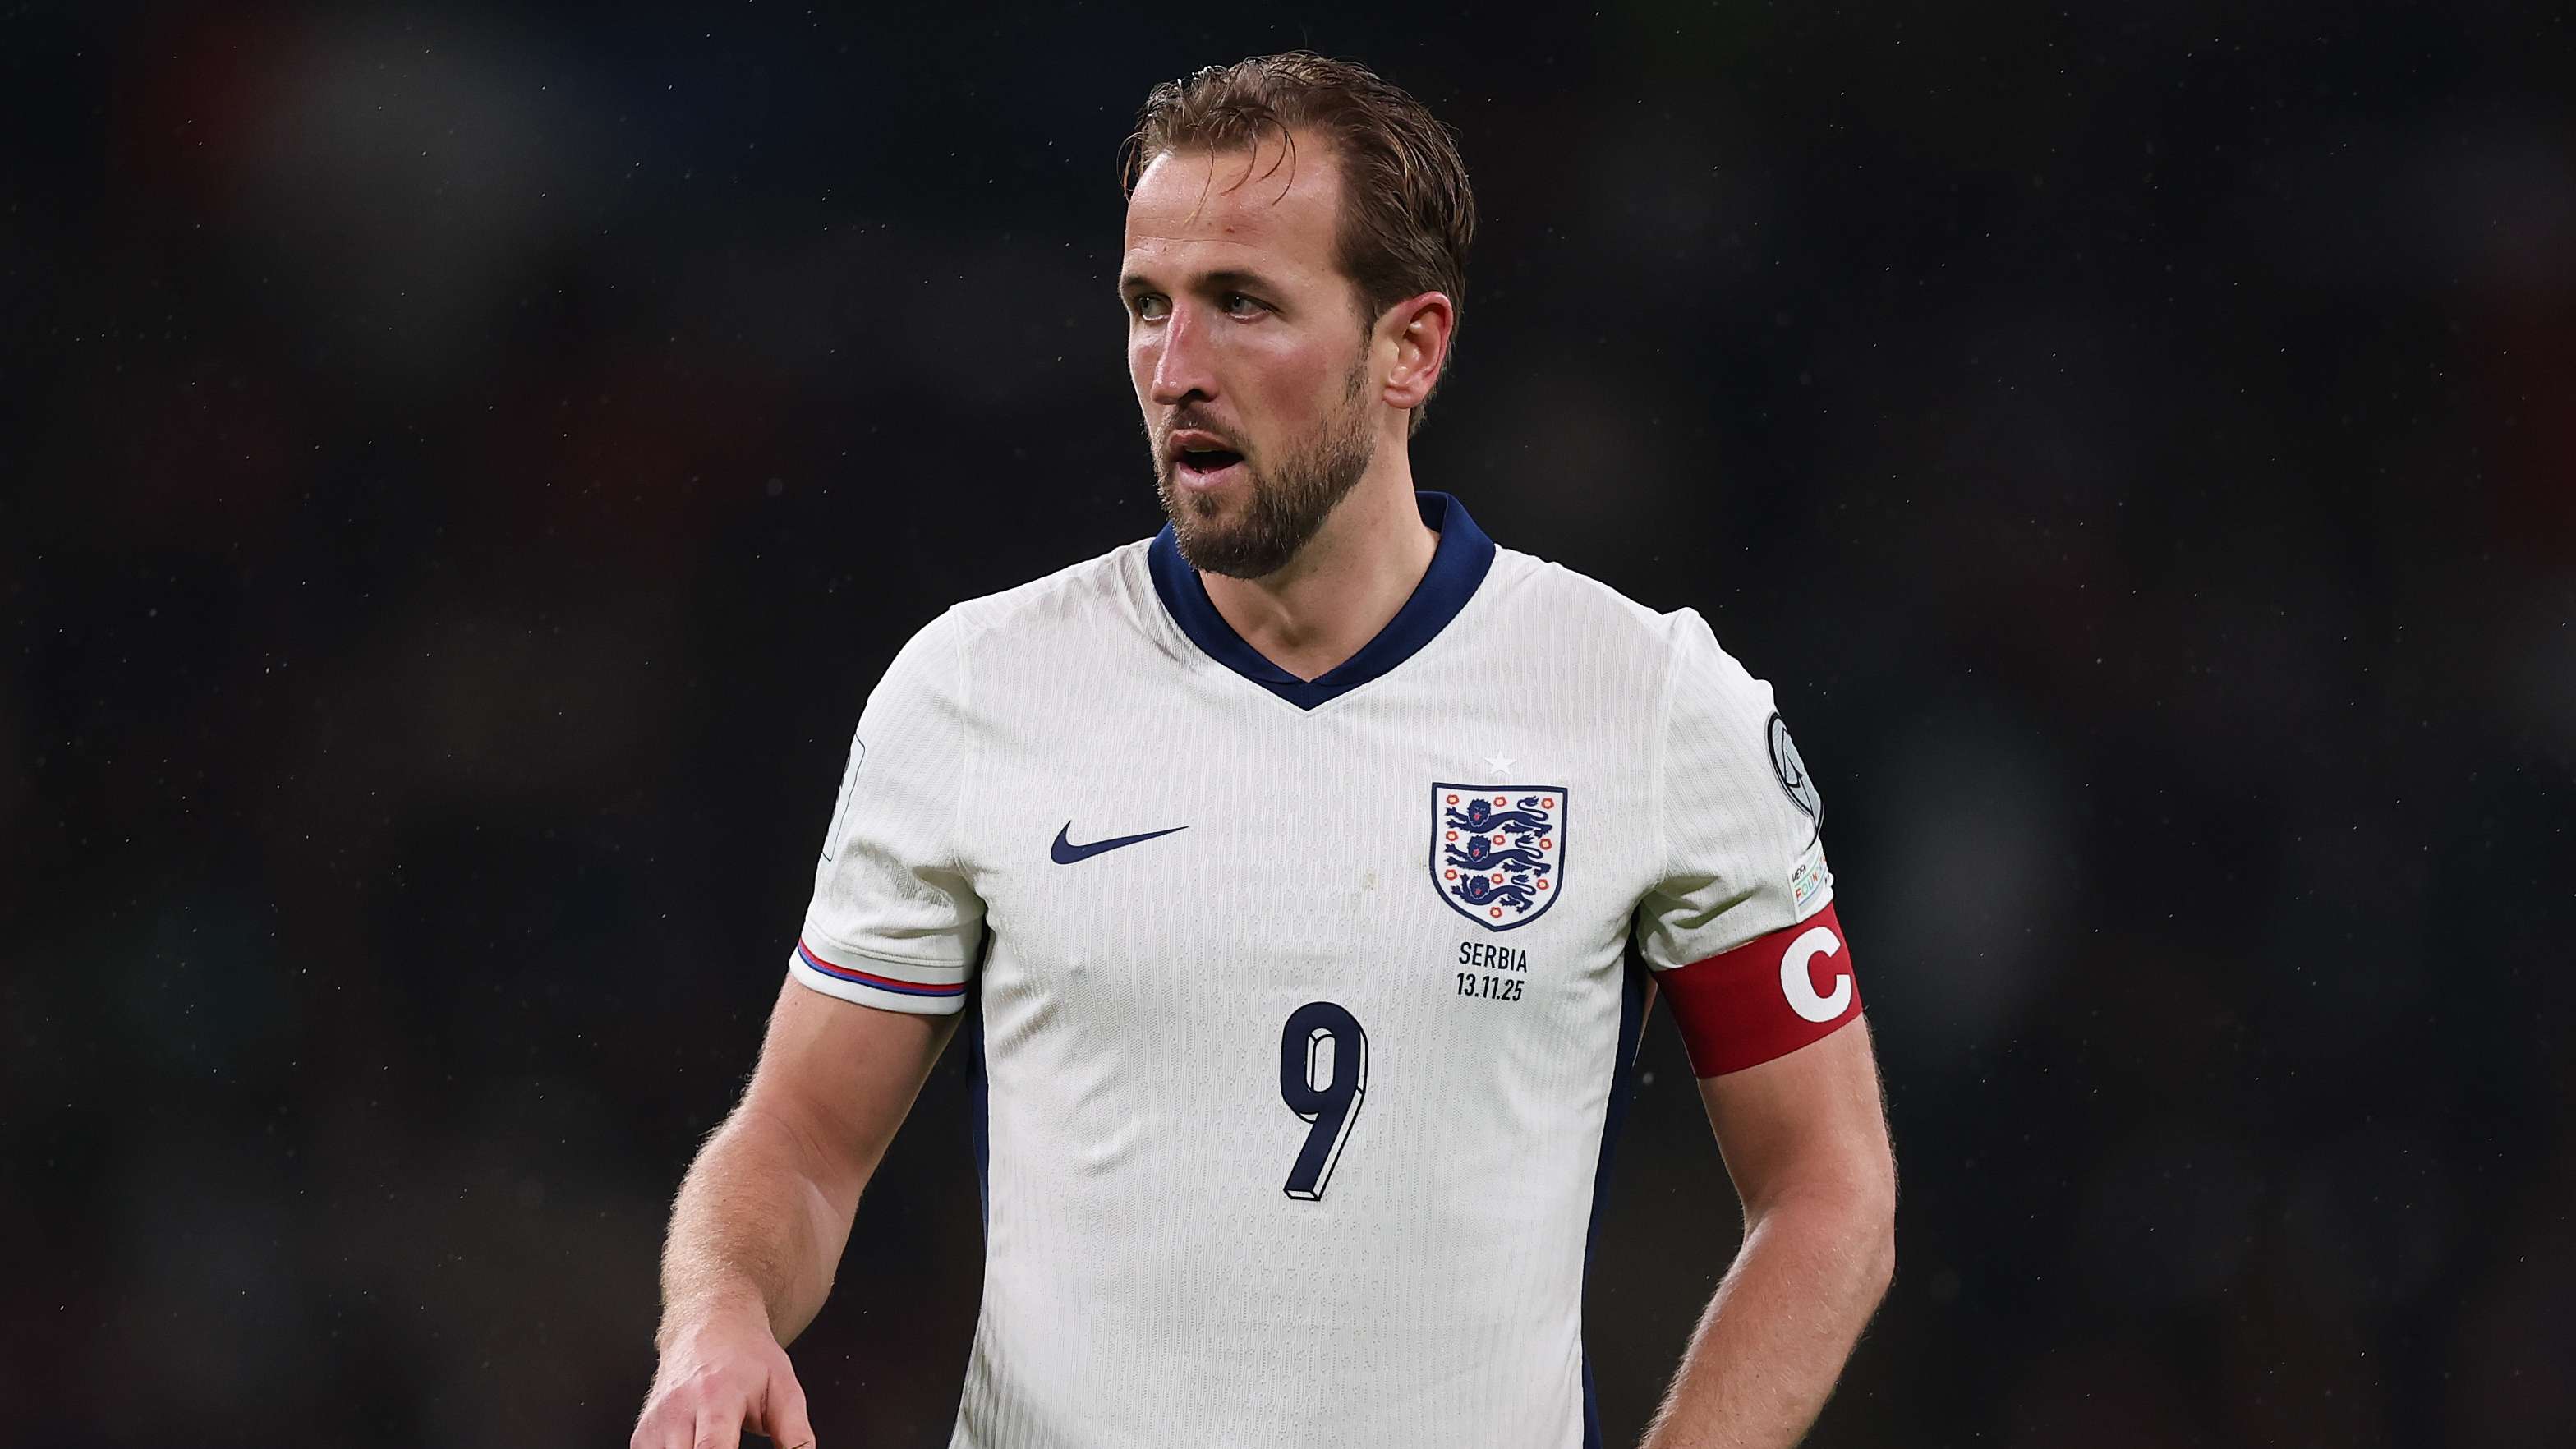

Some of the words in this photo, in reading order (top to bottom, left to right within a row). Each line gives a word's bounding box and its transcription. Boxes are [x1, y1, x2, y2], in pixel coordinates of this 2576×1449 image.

[1457, 973, 1525, 1001] 13.11.25
[1459, 941, 1527, 973] SERBIA
[1780, 927, 1852, 1023] C
[1280, 1001, 1368, 1201] 9
